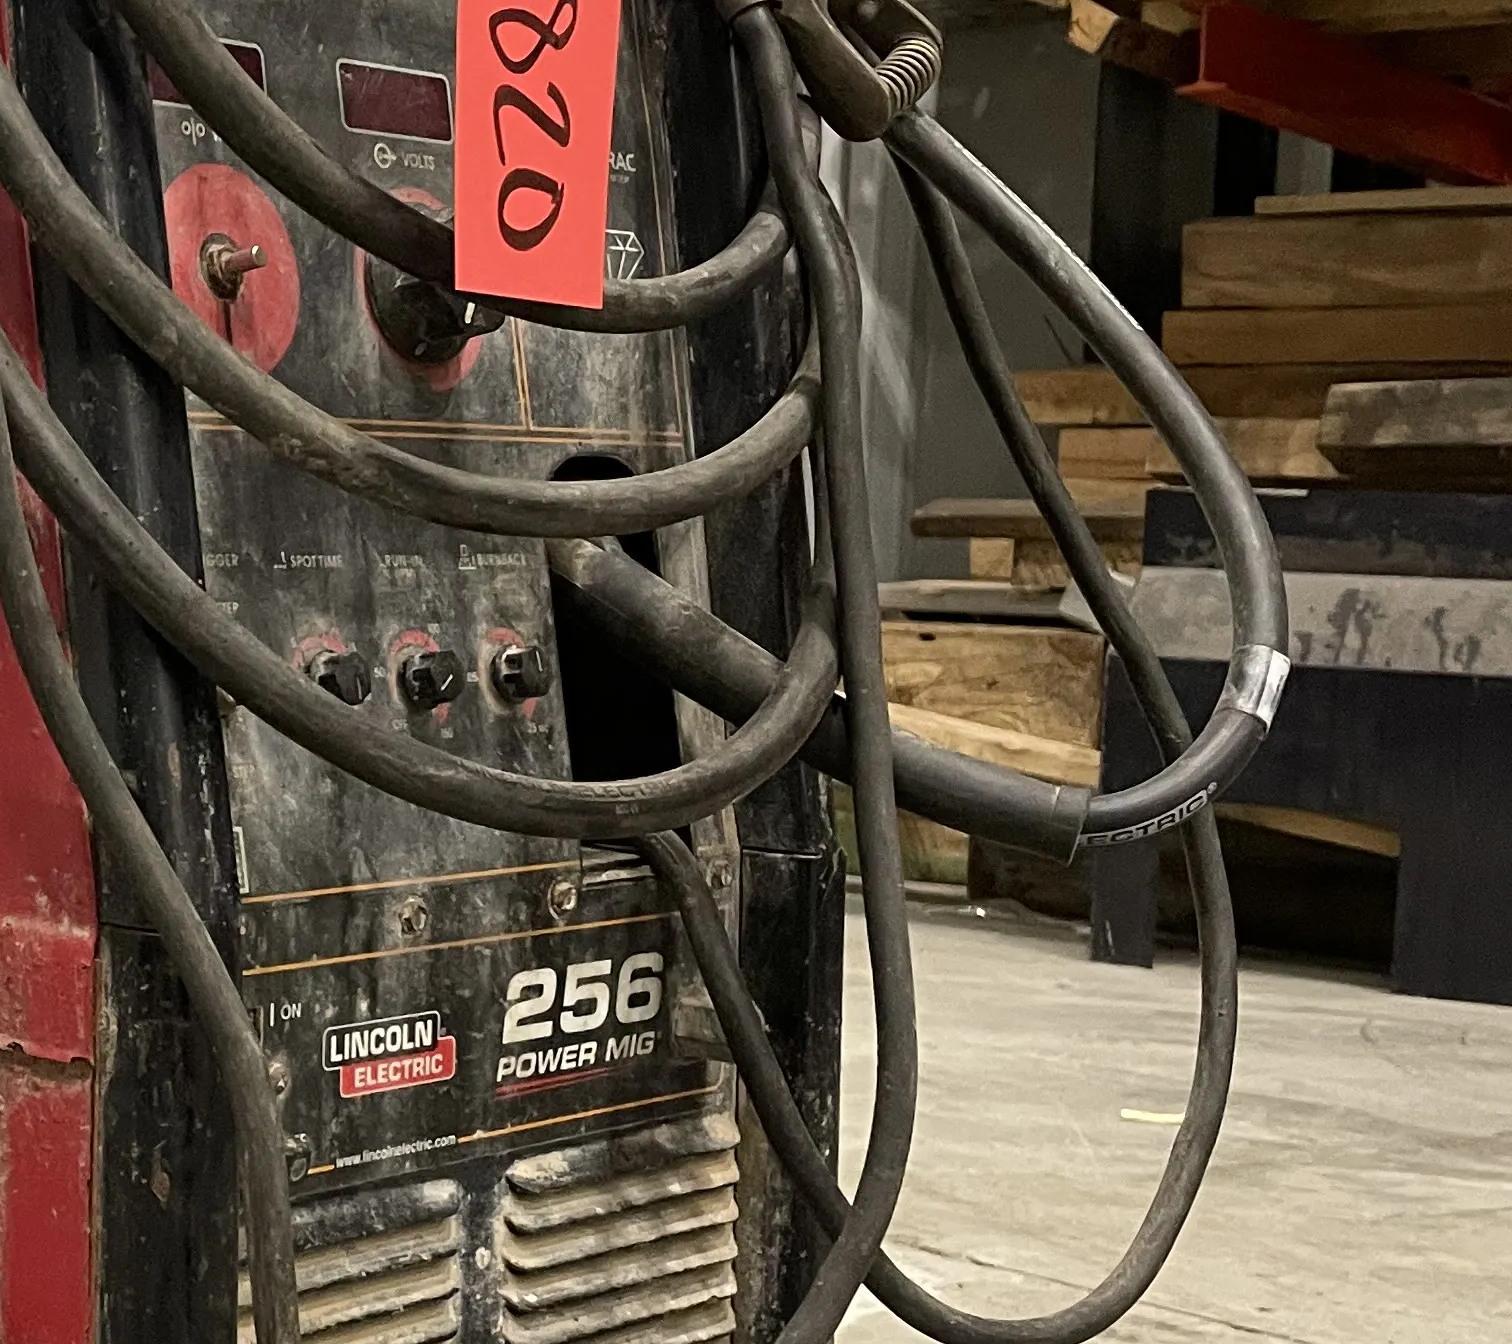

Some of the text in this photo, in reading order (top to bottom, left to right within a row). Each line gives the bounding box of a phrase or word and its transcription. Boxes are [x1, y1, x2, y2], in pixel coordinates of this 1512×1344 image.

[402, 151, 435, 172] VOLTS
[608, 152, 636, 172] RAC
[1084, 790, 1208, 846] ECTRIC
[280, 1002, 302, 1020] ON
[502, 952, 664, 1044] 256
[330, 1019, 433, 1062] LINCOLN
[496, 1031, 656, 1082] POWER MIG
[354, 1053, 443, 1088] ELECTRIC
[336, 1134, 456, 1168] www.lincolnelectric.com
